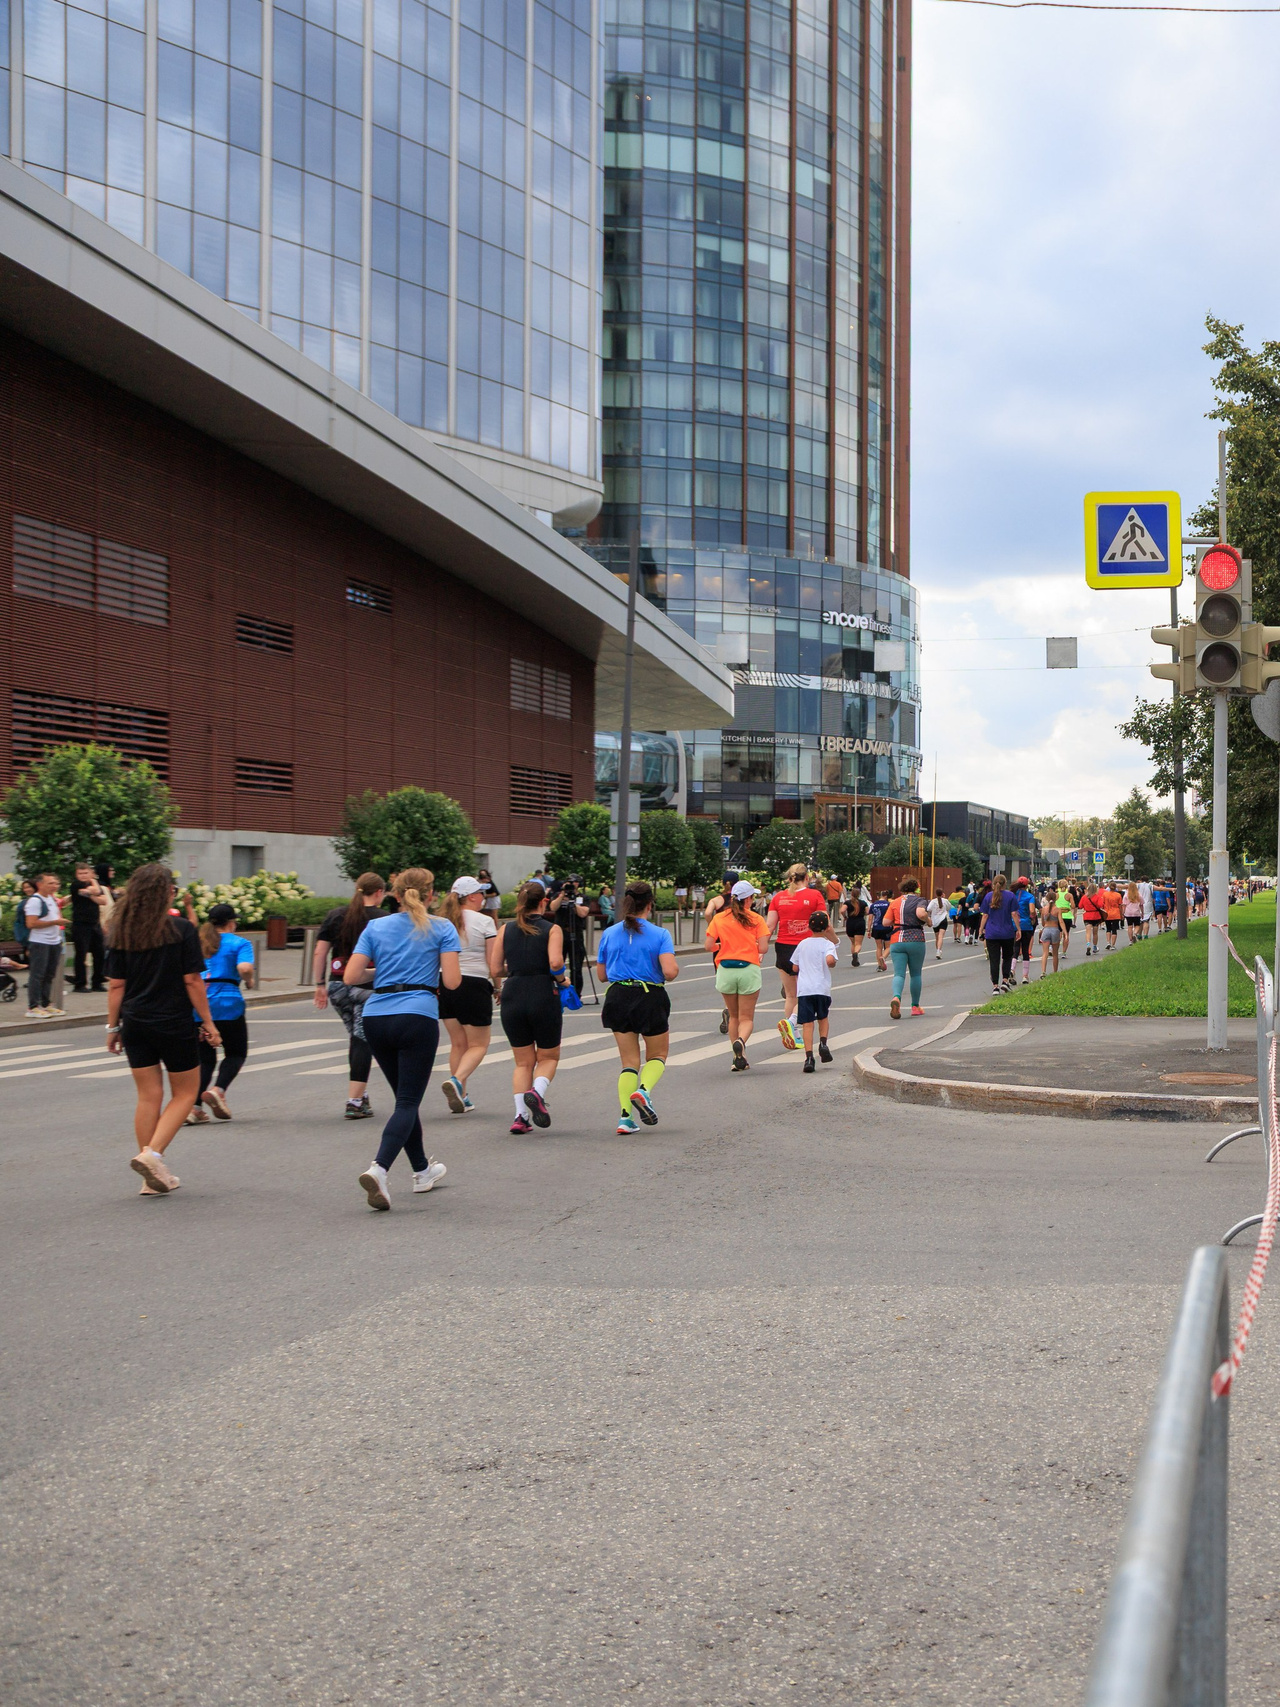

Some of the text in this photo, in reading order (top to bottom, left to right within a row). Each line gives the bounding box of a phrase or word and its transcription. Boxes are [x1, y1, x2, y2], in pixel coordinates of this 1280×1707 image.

[822, 610, 894, 635] encore fitness
[720, 735, 806, 746] KITCHEN BAKERY WINE
[827, 736, 893, 757] BREADWAY
